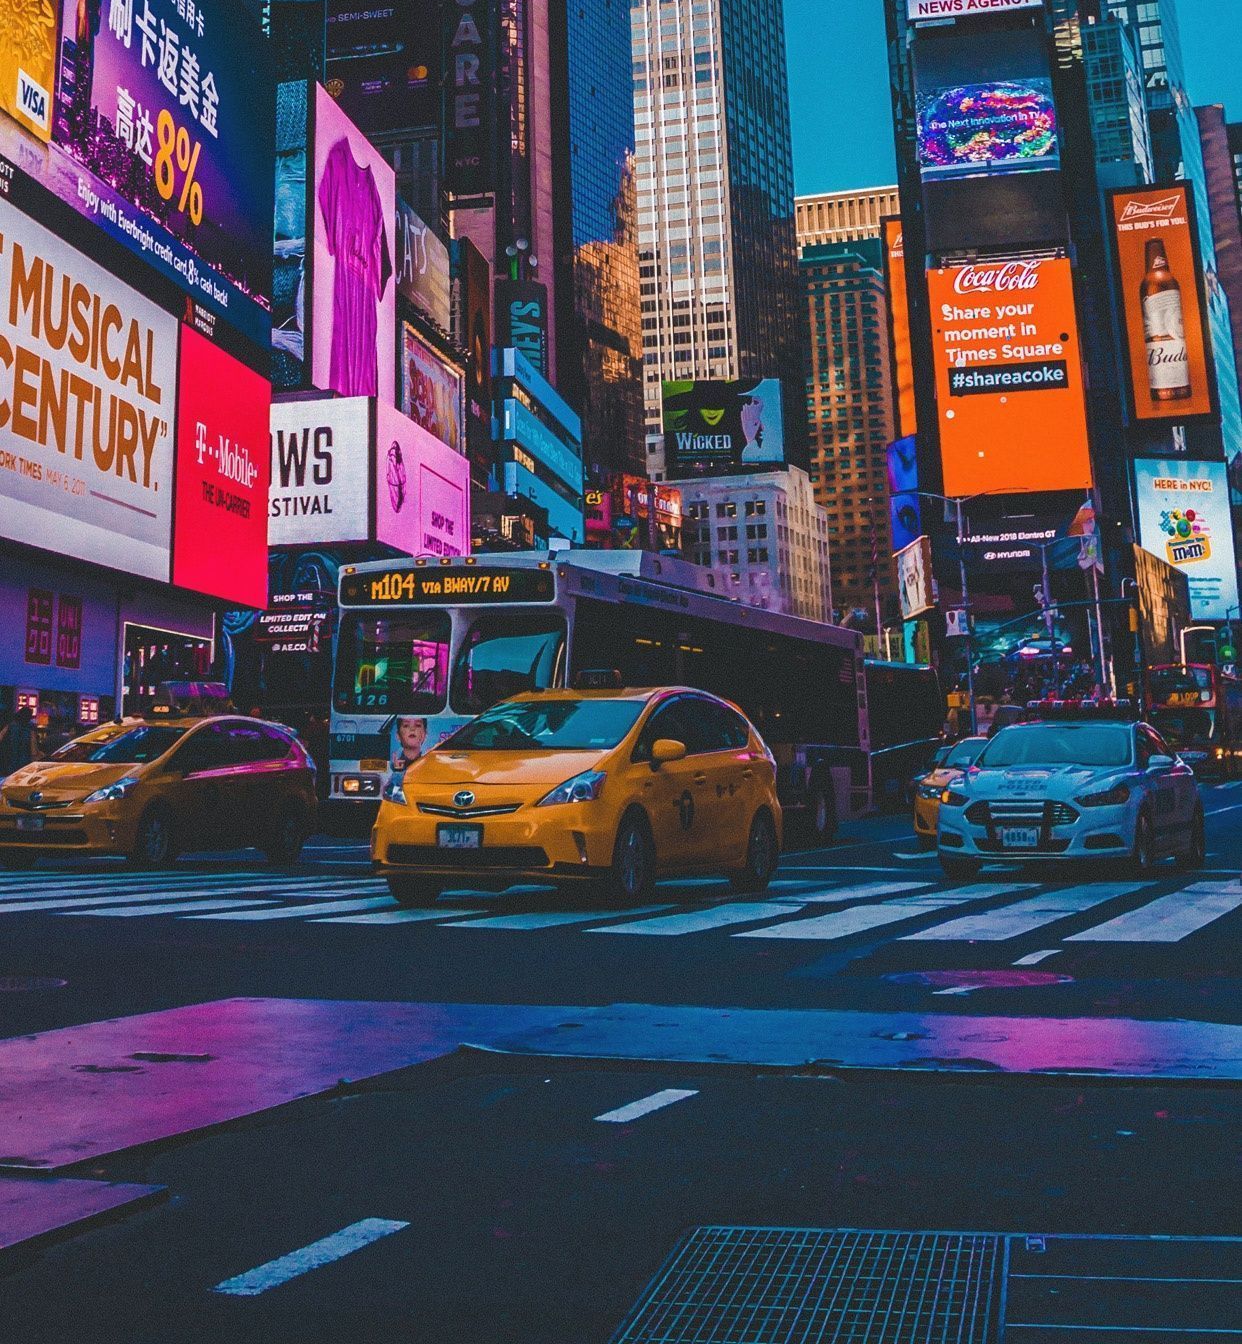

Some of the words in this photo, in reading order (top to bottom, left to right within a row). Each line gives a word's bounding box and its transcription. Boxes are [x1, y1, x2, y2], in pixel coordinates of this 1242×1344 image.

[918, 0, 965, 17] NEWS
[19, 78, 47, 122] VISA
[0, 161, 14, 180] OTT
[1117, 223, 1134, 232] THIS
[1156, 219, 1170, 228] FOR
[77, 177, 100, 214] Enjoy
[100, 199, 117, 224] with
[118, 209, 154, 252] Everbright
[154, 241, 174, 266] credit
[200, 276, 213, 296] cash
[953, 260, 1041, 295] Coca-Cola
[8, 242, 162, 404] MUSICAL
[942, 304, 991, 322] Share
[995, 303, 1035, 321] your
[944, 326, 1017, 343] moment
[1020, 322, 1037, 337] in
[946, 345, 998, 364] Times
[1001, 343, 1063, 360] Square
[952, 367, 1065, 390] #shareacoke
[0, 450, 17, 472] ORK
[19, 457, 42, 481] TIMES
[269, 426, 333, 488] WS
[1154, 479, 1178, 490] HERE
[1189, 481, 1212, 491] NYC!
[202, 480, 214, 502] THE
[215, 487, 251, 520] UN-CARRIER
[268, 494, 333, 518] STIVAL
[431, 511, 445, 531] SHOP
[445, 518, 454, 536] THE
[371, 573, 416, 600] M104
[422, 581, 442, 594] VIA
[444, 576, 490, 594] BWAY/7
[493, 576, 510, 593] AV
[273, 594, 296, 602] SHOP
[297, 593, 313, 601] THE
[260, 614, 292, 623] LIMITED
[293, 613, 326, 622] EDITON
[268, 624, 309, 633] COLLECTI
[281, 643, 307, 652] AE.CO
[356, 694, 388, 706] 126
